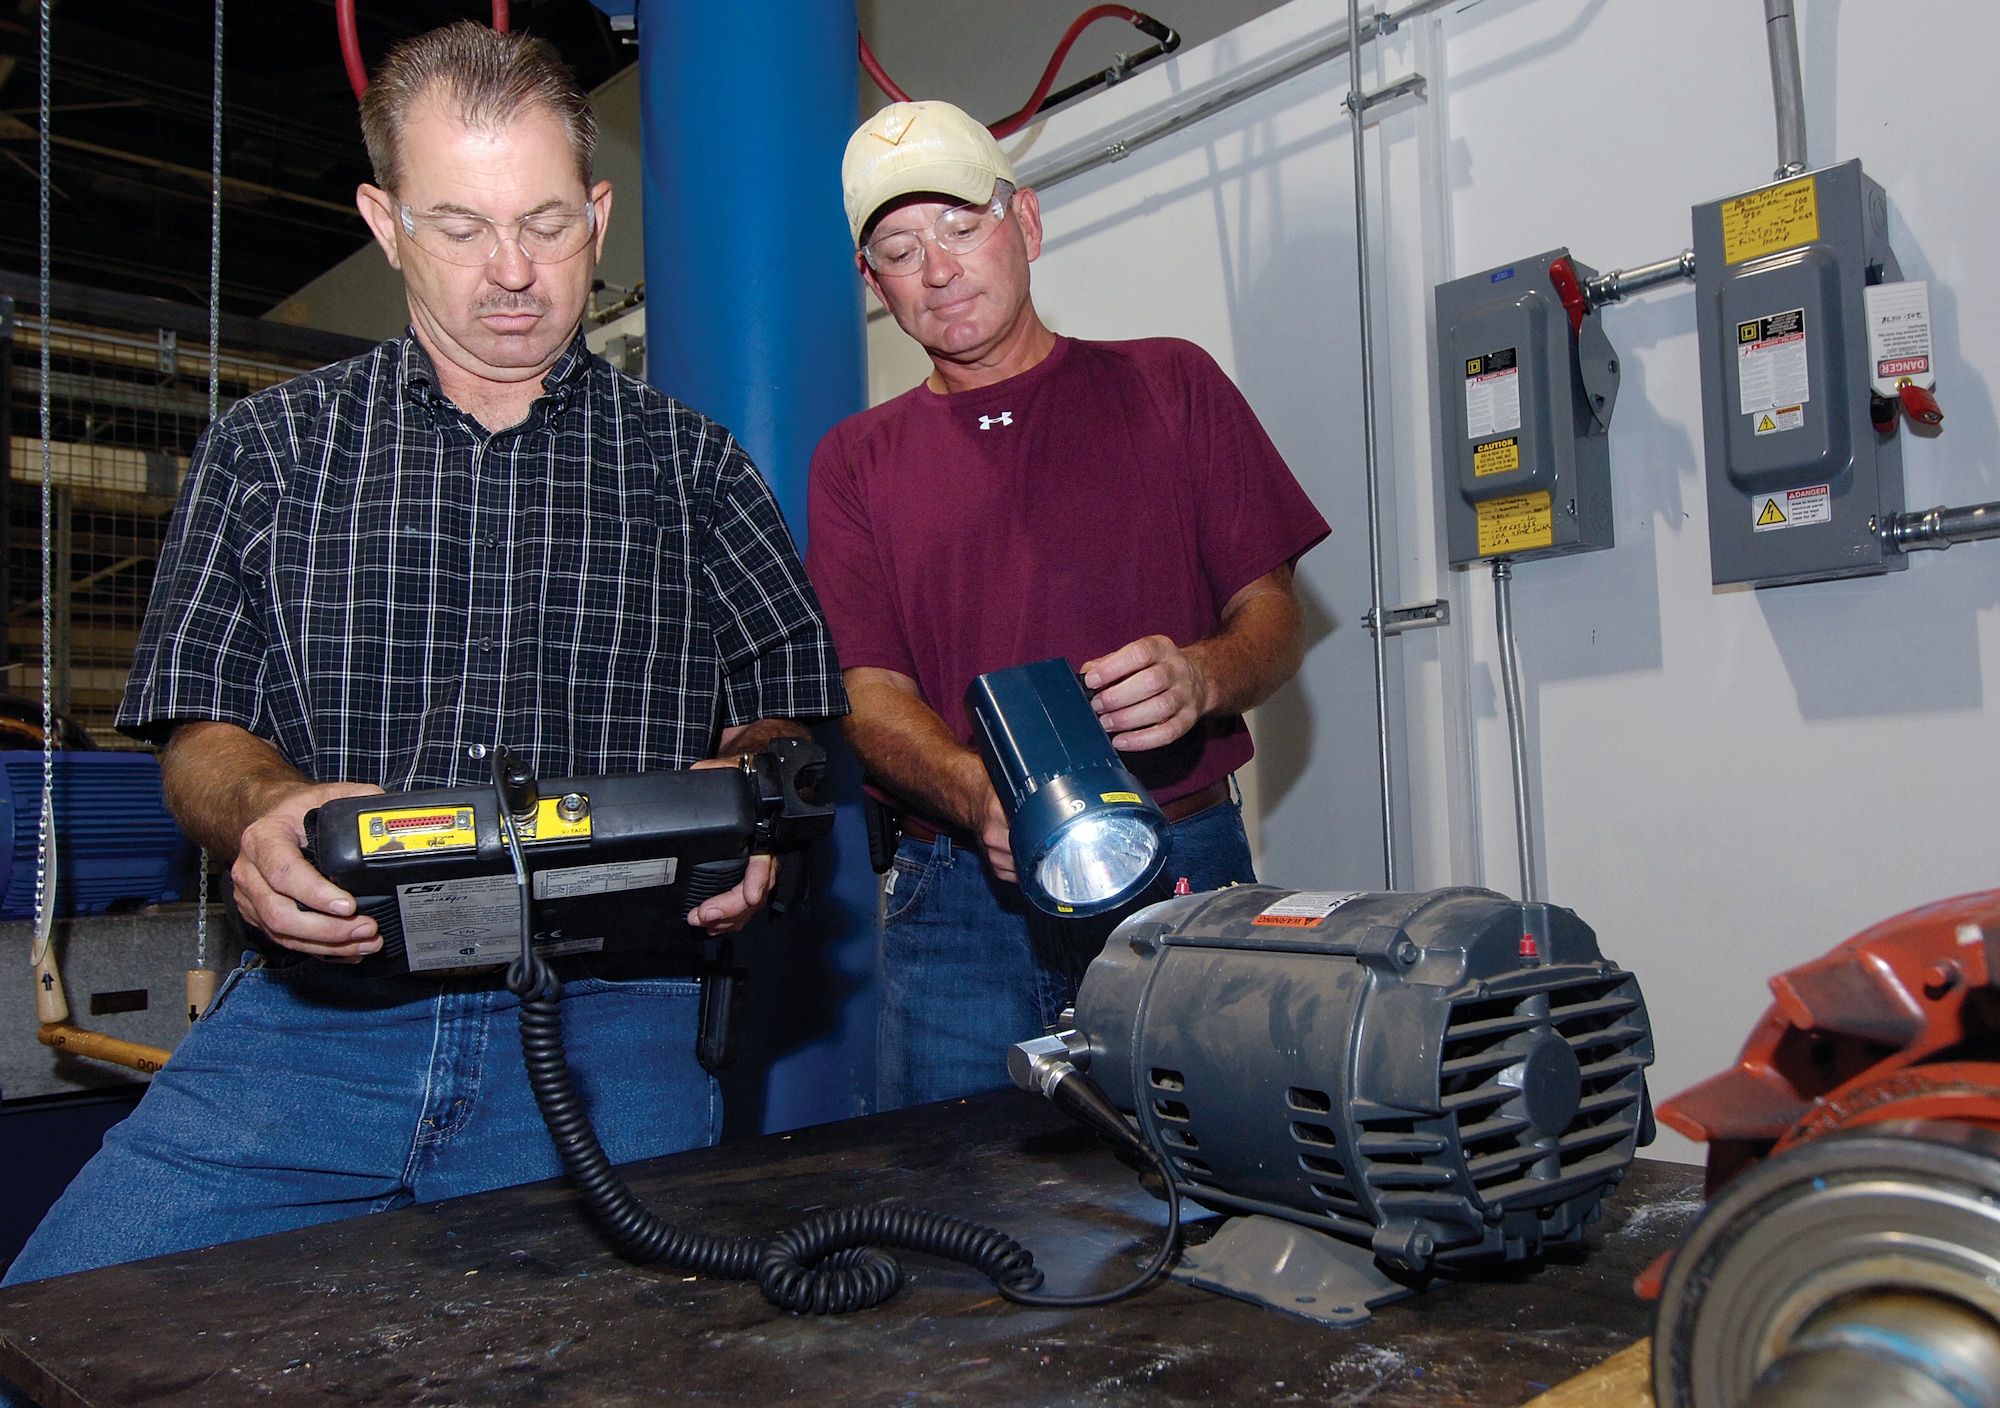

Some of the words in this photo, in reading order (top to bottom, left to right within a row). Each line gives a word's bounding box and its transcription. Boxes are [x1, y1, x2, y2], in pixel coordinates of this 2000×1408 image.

[1882, 359, 1925, 373] DANGER
[1478, 439, 1513, 452] CAUTION
[1795, 487, 1826, 498] DANGER
[1257, 916, 1302, 925] WARNING
[50, 1034, 65, 1046] UP
